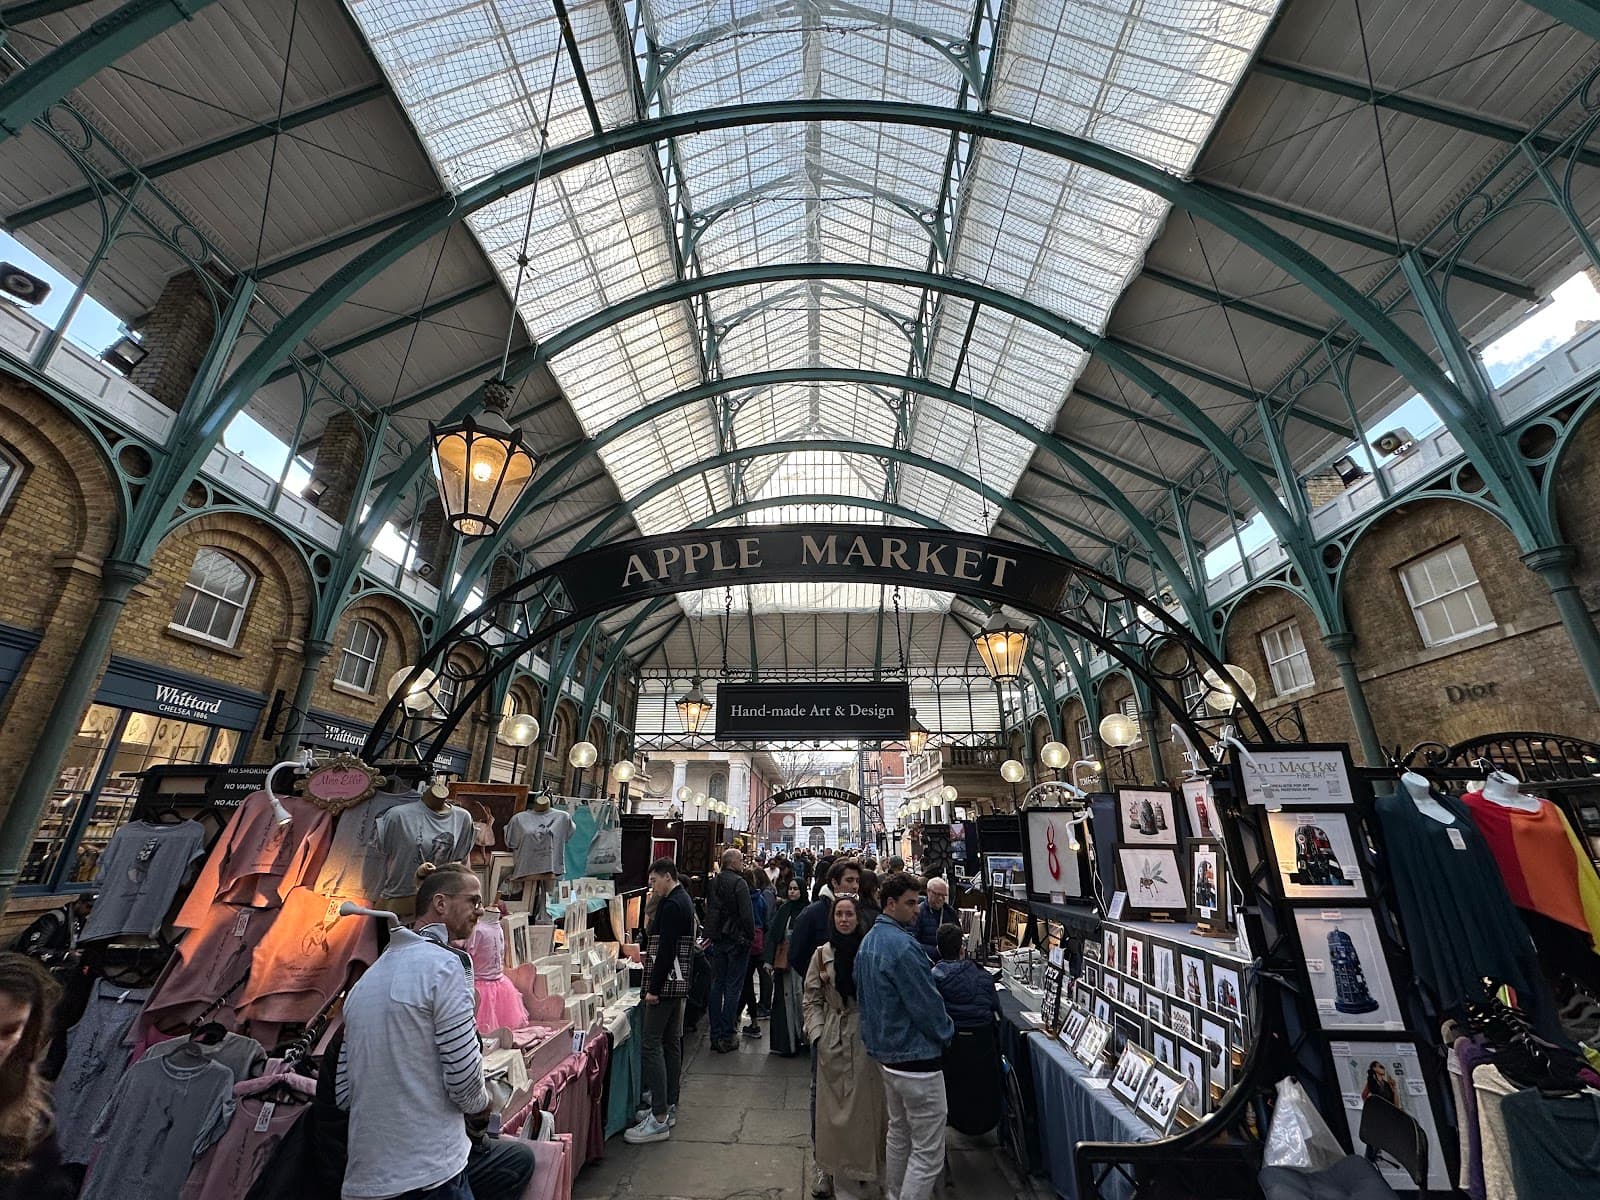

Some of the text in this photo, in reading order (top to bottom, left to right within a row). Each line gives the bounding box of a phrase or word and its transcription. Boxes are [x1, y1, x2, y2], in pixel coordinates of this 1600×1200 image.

[622, 535, 1017, 588] APPLE MARKET
[155, 684, 222, 713] Whittard
[1445, 681, 1496, 704] Dior
[158, 703, 208, 720] CHELSEA 1886
[730, 704, 894, 719] Hand-made Art & Design
[784, 787, 851, 801] APPLE MARKET
